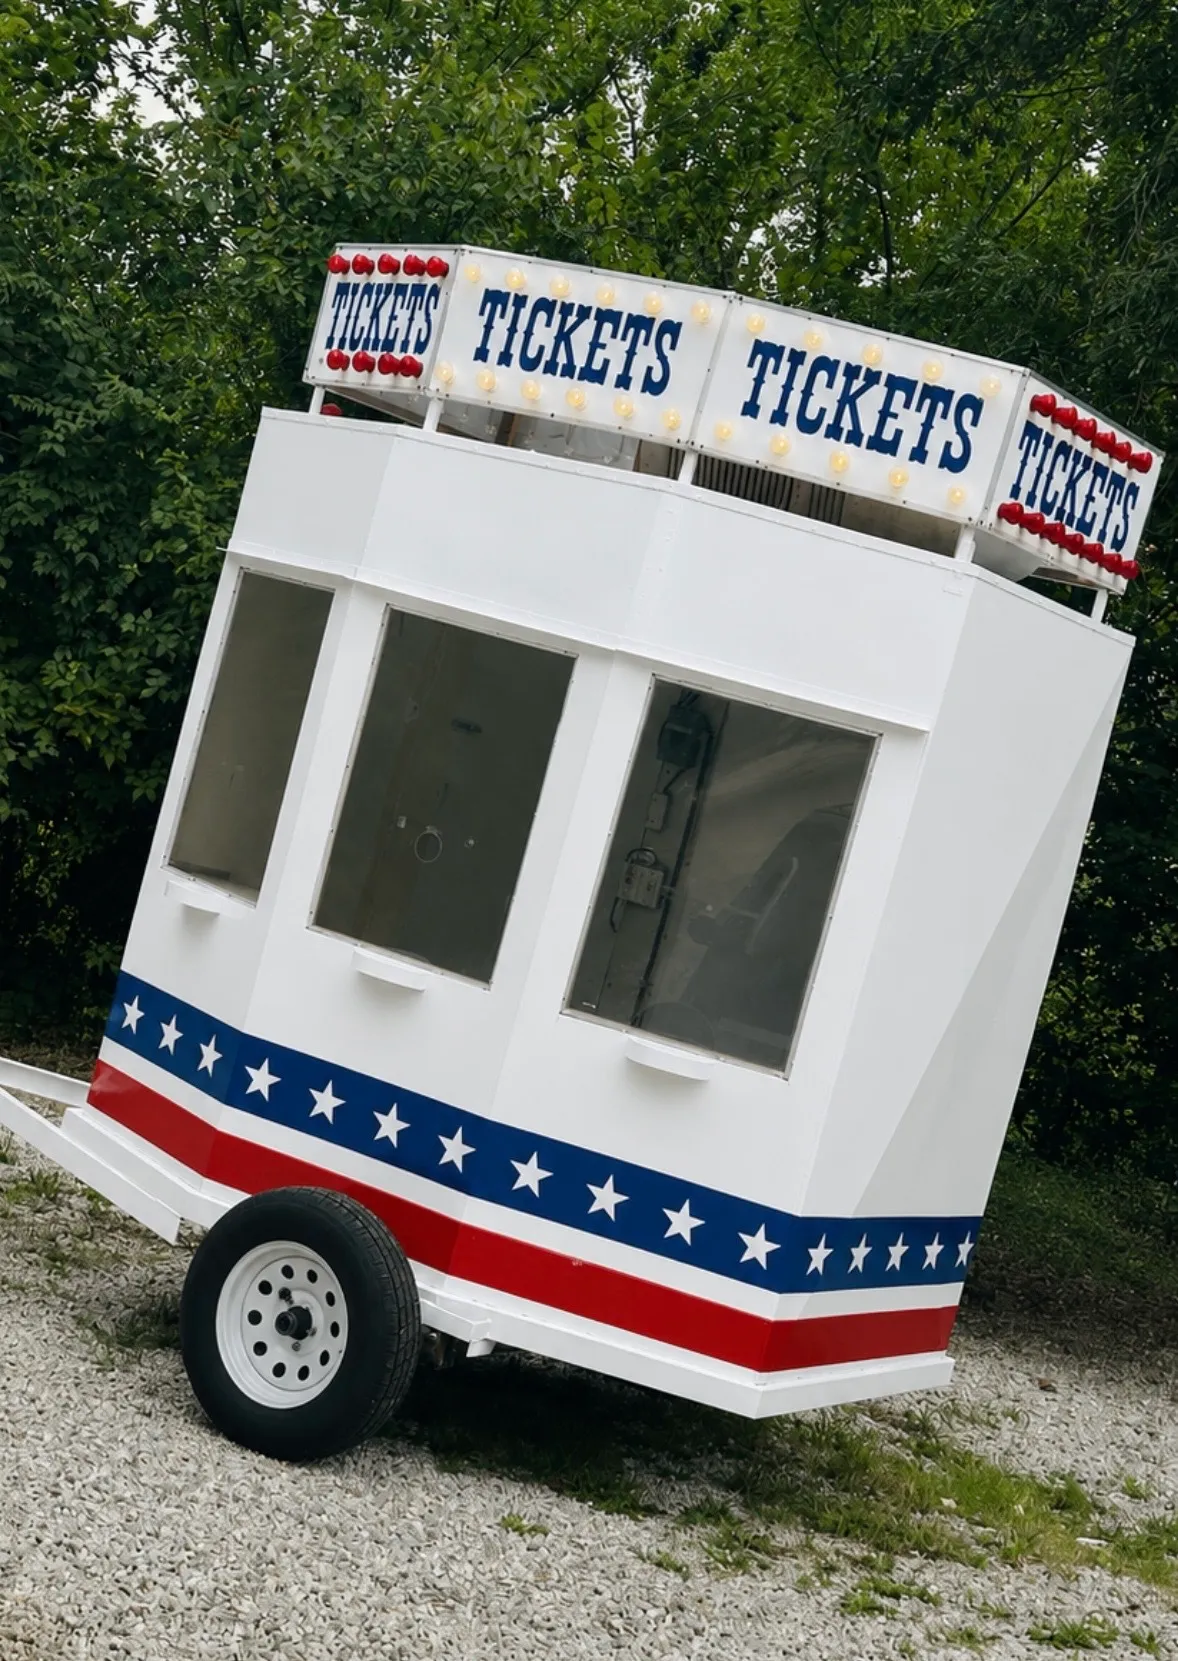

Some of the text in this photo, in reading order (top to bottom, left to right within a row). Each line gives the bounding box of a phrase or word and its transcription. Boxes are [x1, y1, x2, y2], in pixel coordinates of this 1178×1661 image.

[325, 282, 440, 355] TICKETS
[473, 288, 682, 396] TICKETS
[740, 338, 985, 474] TICKETS
[1010, 421, 1141, 552] TICKETS
